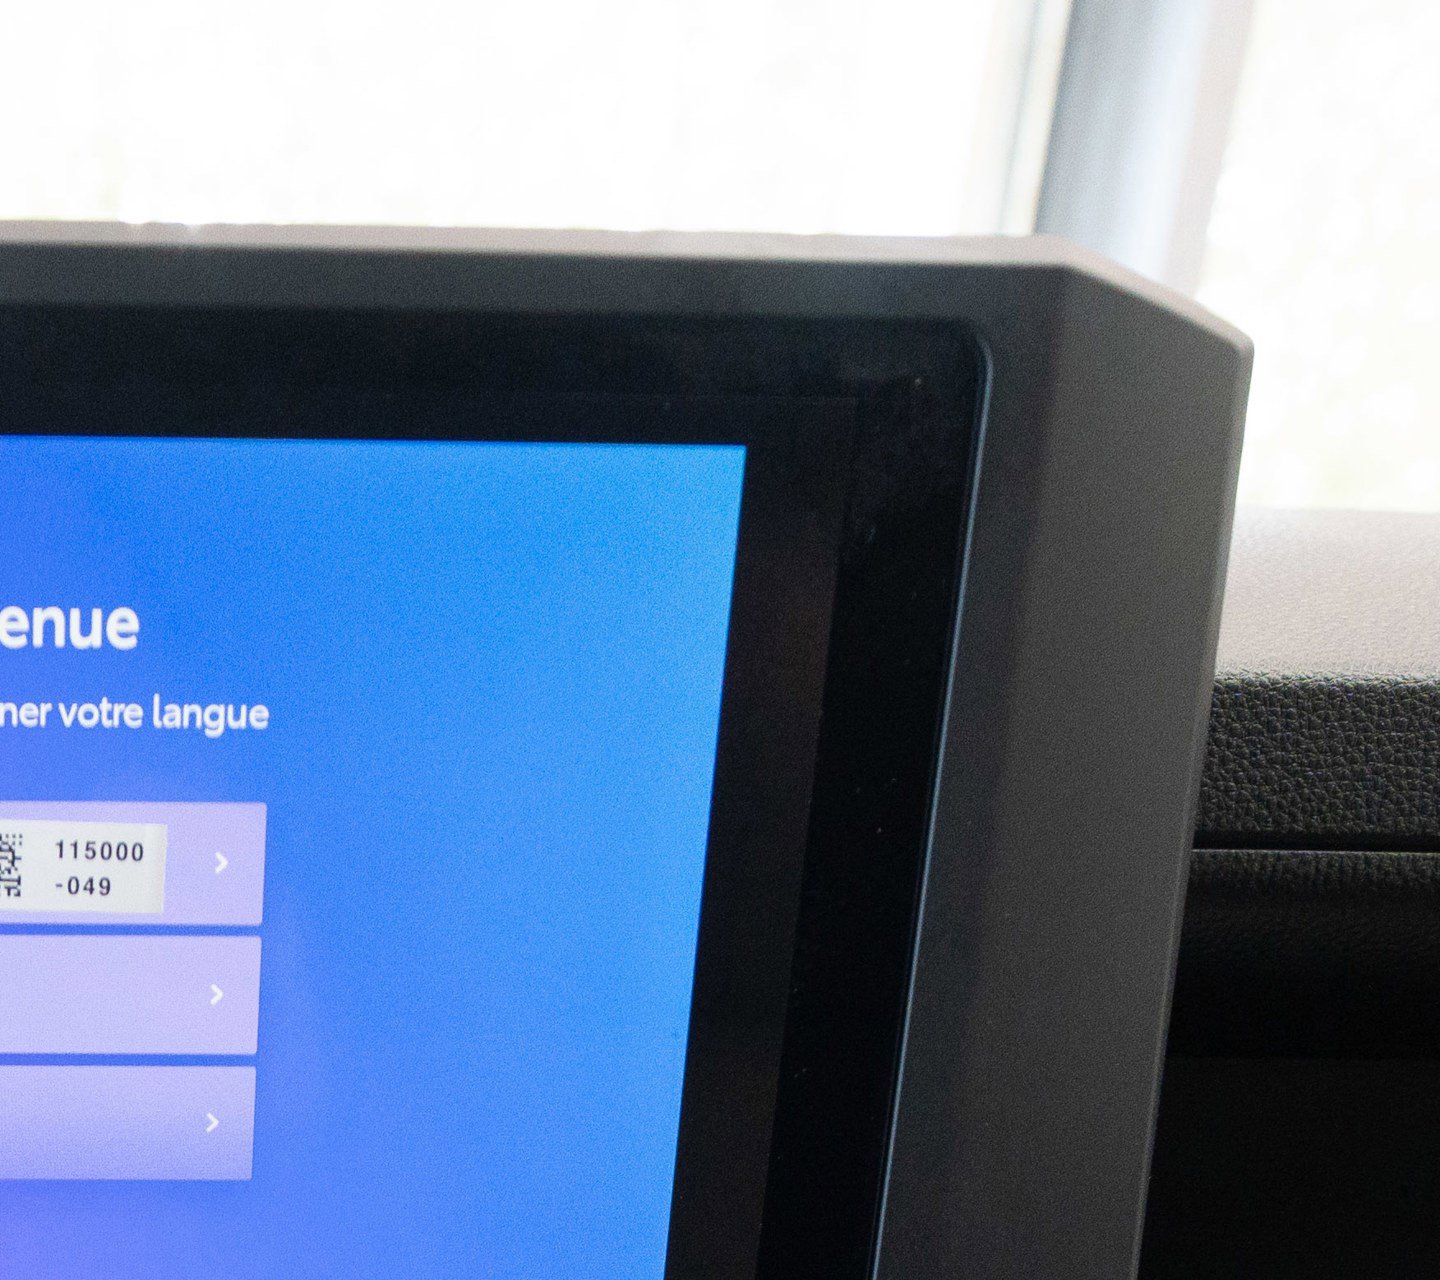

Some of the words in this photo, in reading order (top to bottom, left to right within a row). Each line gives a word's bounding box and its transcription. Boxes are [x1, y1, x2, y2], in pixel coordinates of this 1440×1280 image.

[58, 696, 143, 729] votre
[152, 694, 270, 738] langue
[55, 839, 146, 863] 115000
[55, 875, 113, 897] -049
